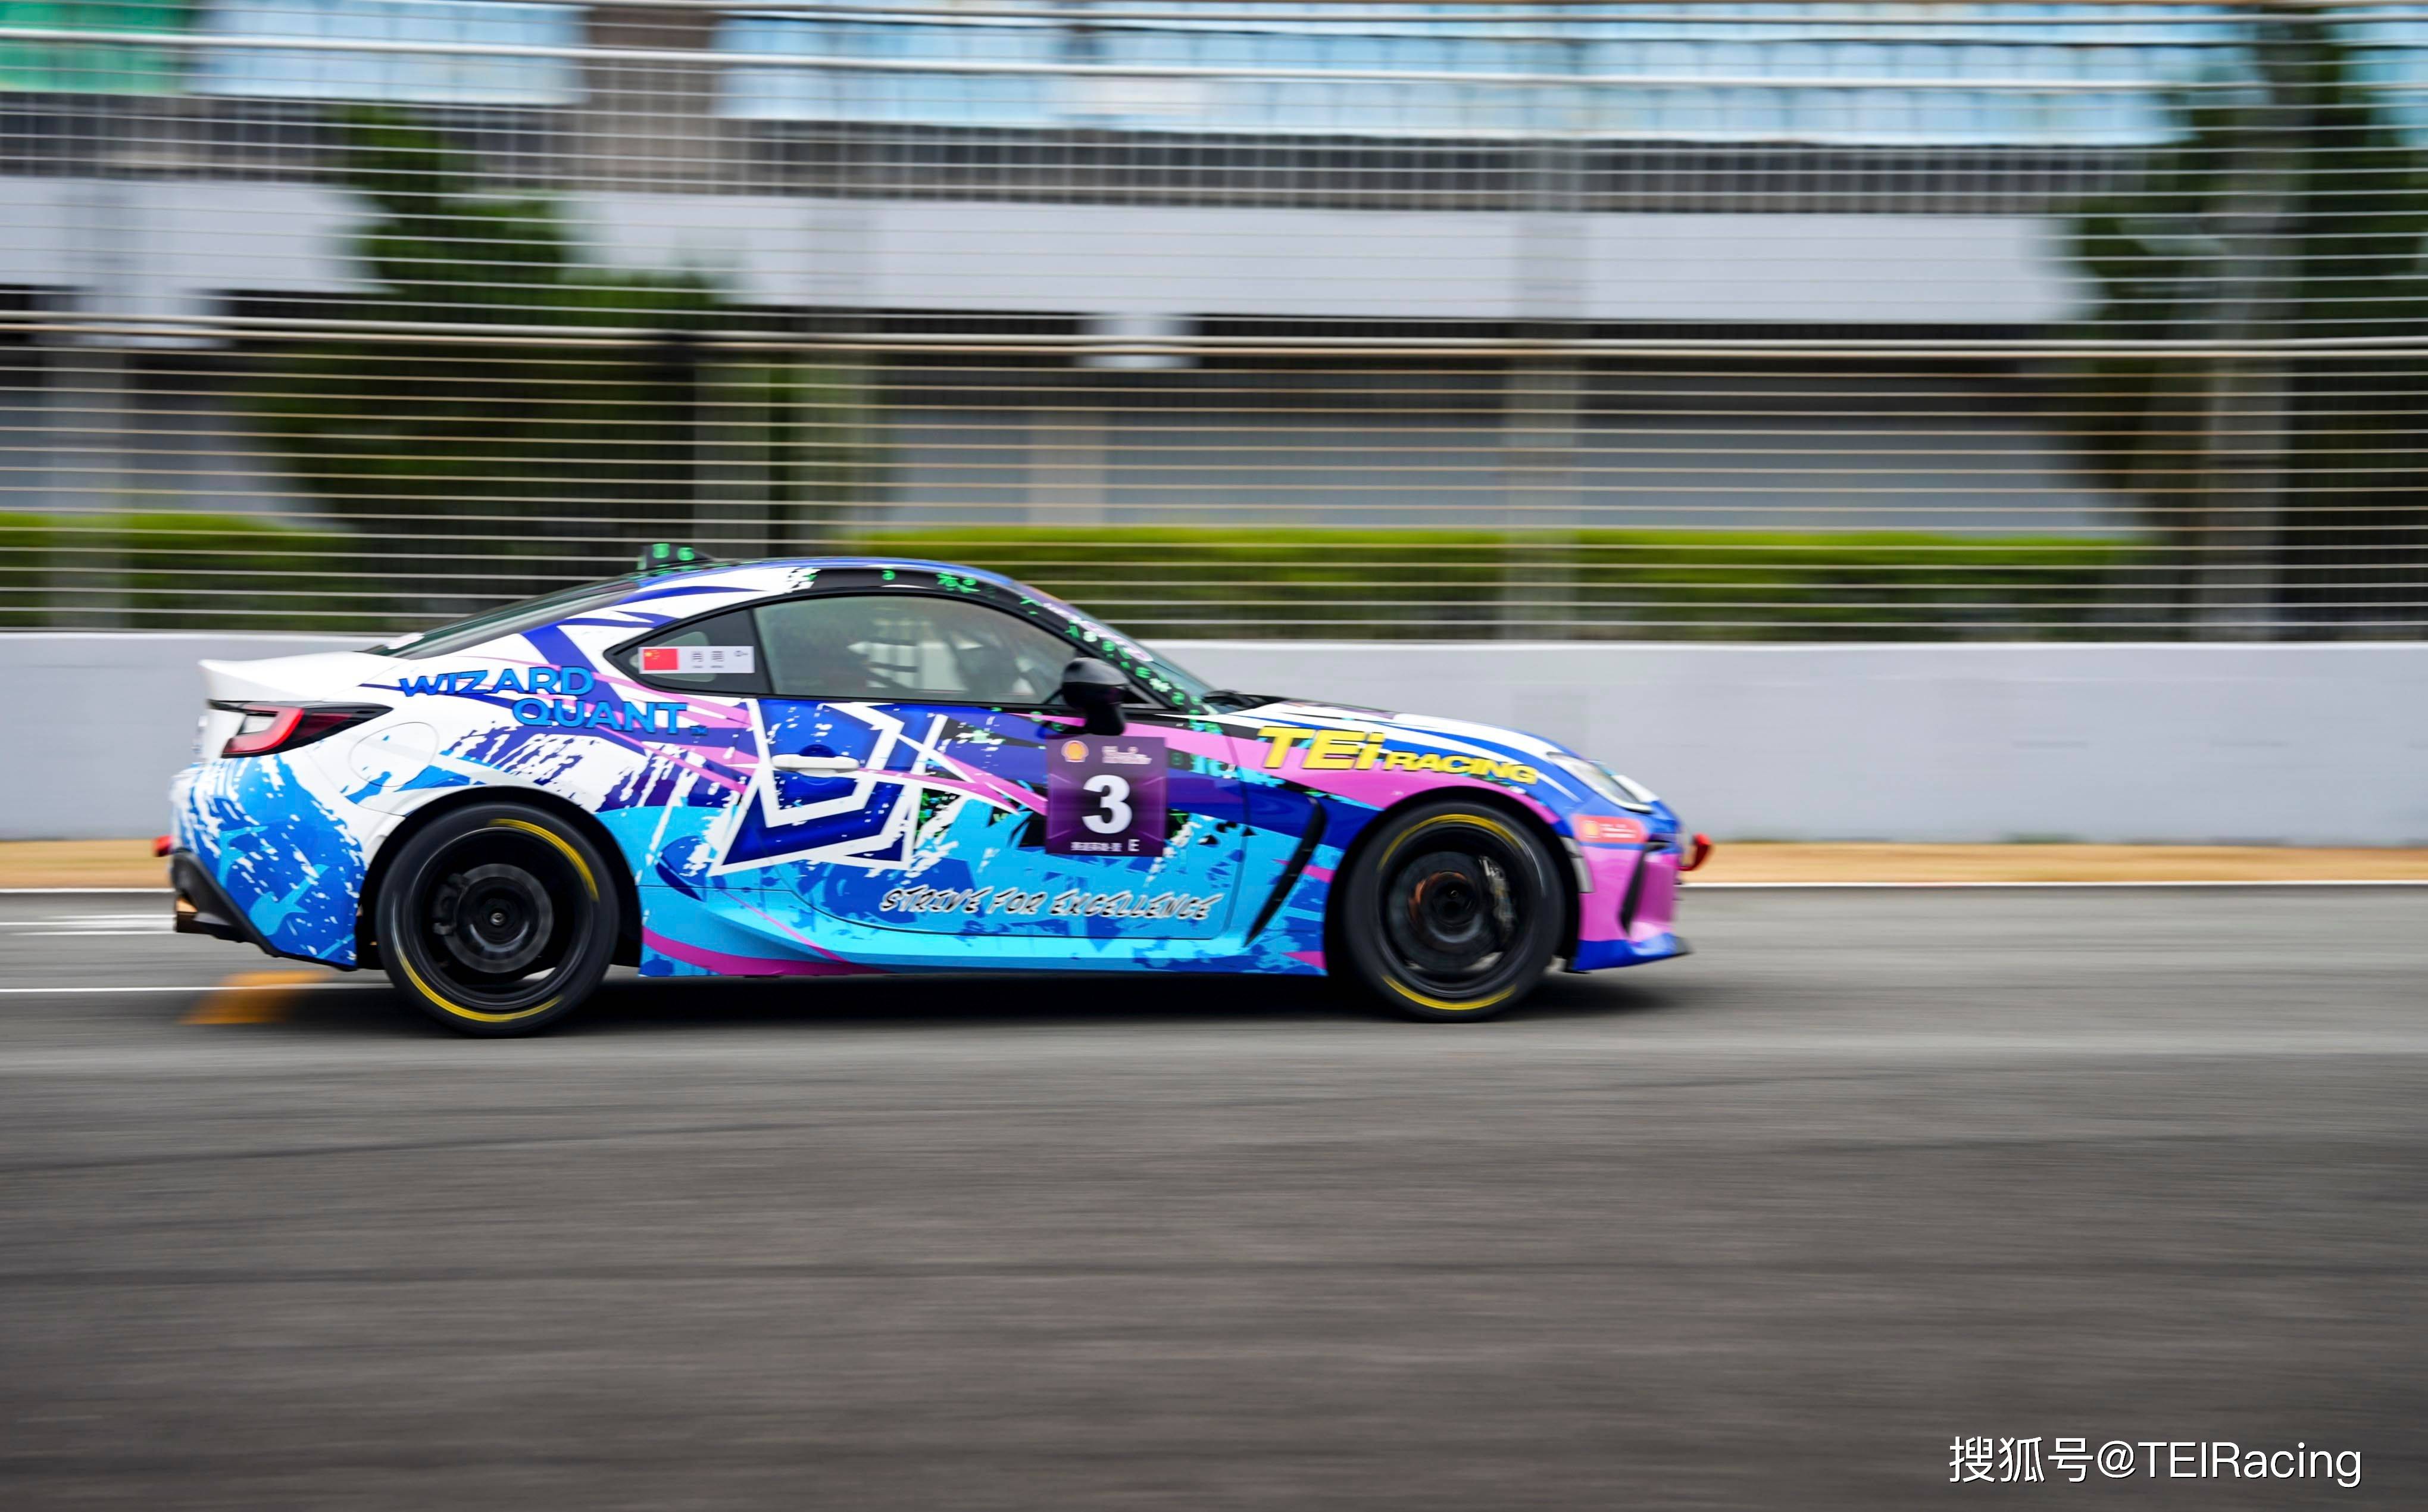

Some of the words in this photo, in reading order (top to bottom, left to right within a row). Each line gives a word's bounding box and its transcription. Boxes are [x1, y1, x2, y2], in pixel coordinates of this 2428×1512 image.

[398, 666, 595, 697] WIZARD
[512, 698, 688, 735] QUANT
[1382, 751, 1539, 785] RACING
[1082, 774, 1133, 834] 3
[1127, 838, 1140, 852] E
[879, 883, 995, 913] STRIVE
[986, 886, 1047, 915] FOR
[1049, 888, 1224, 920] EXCELLENCE
